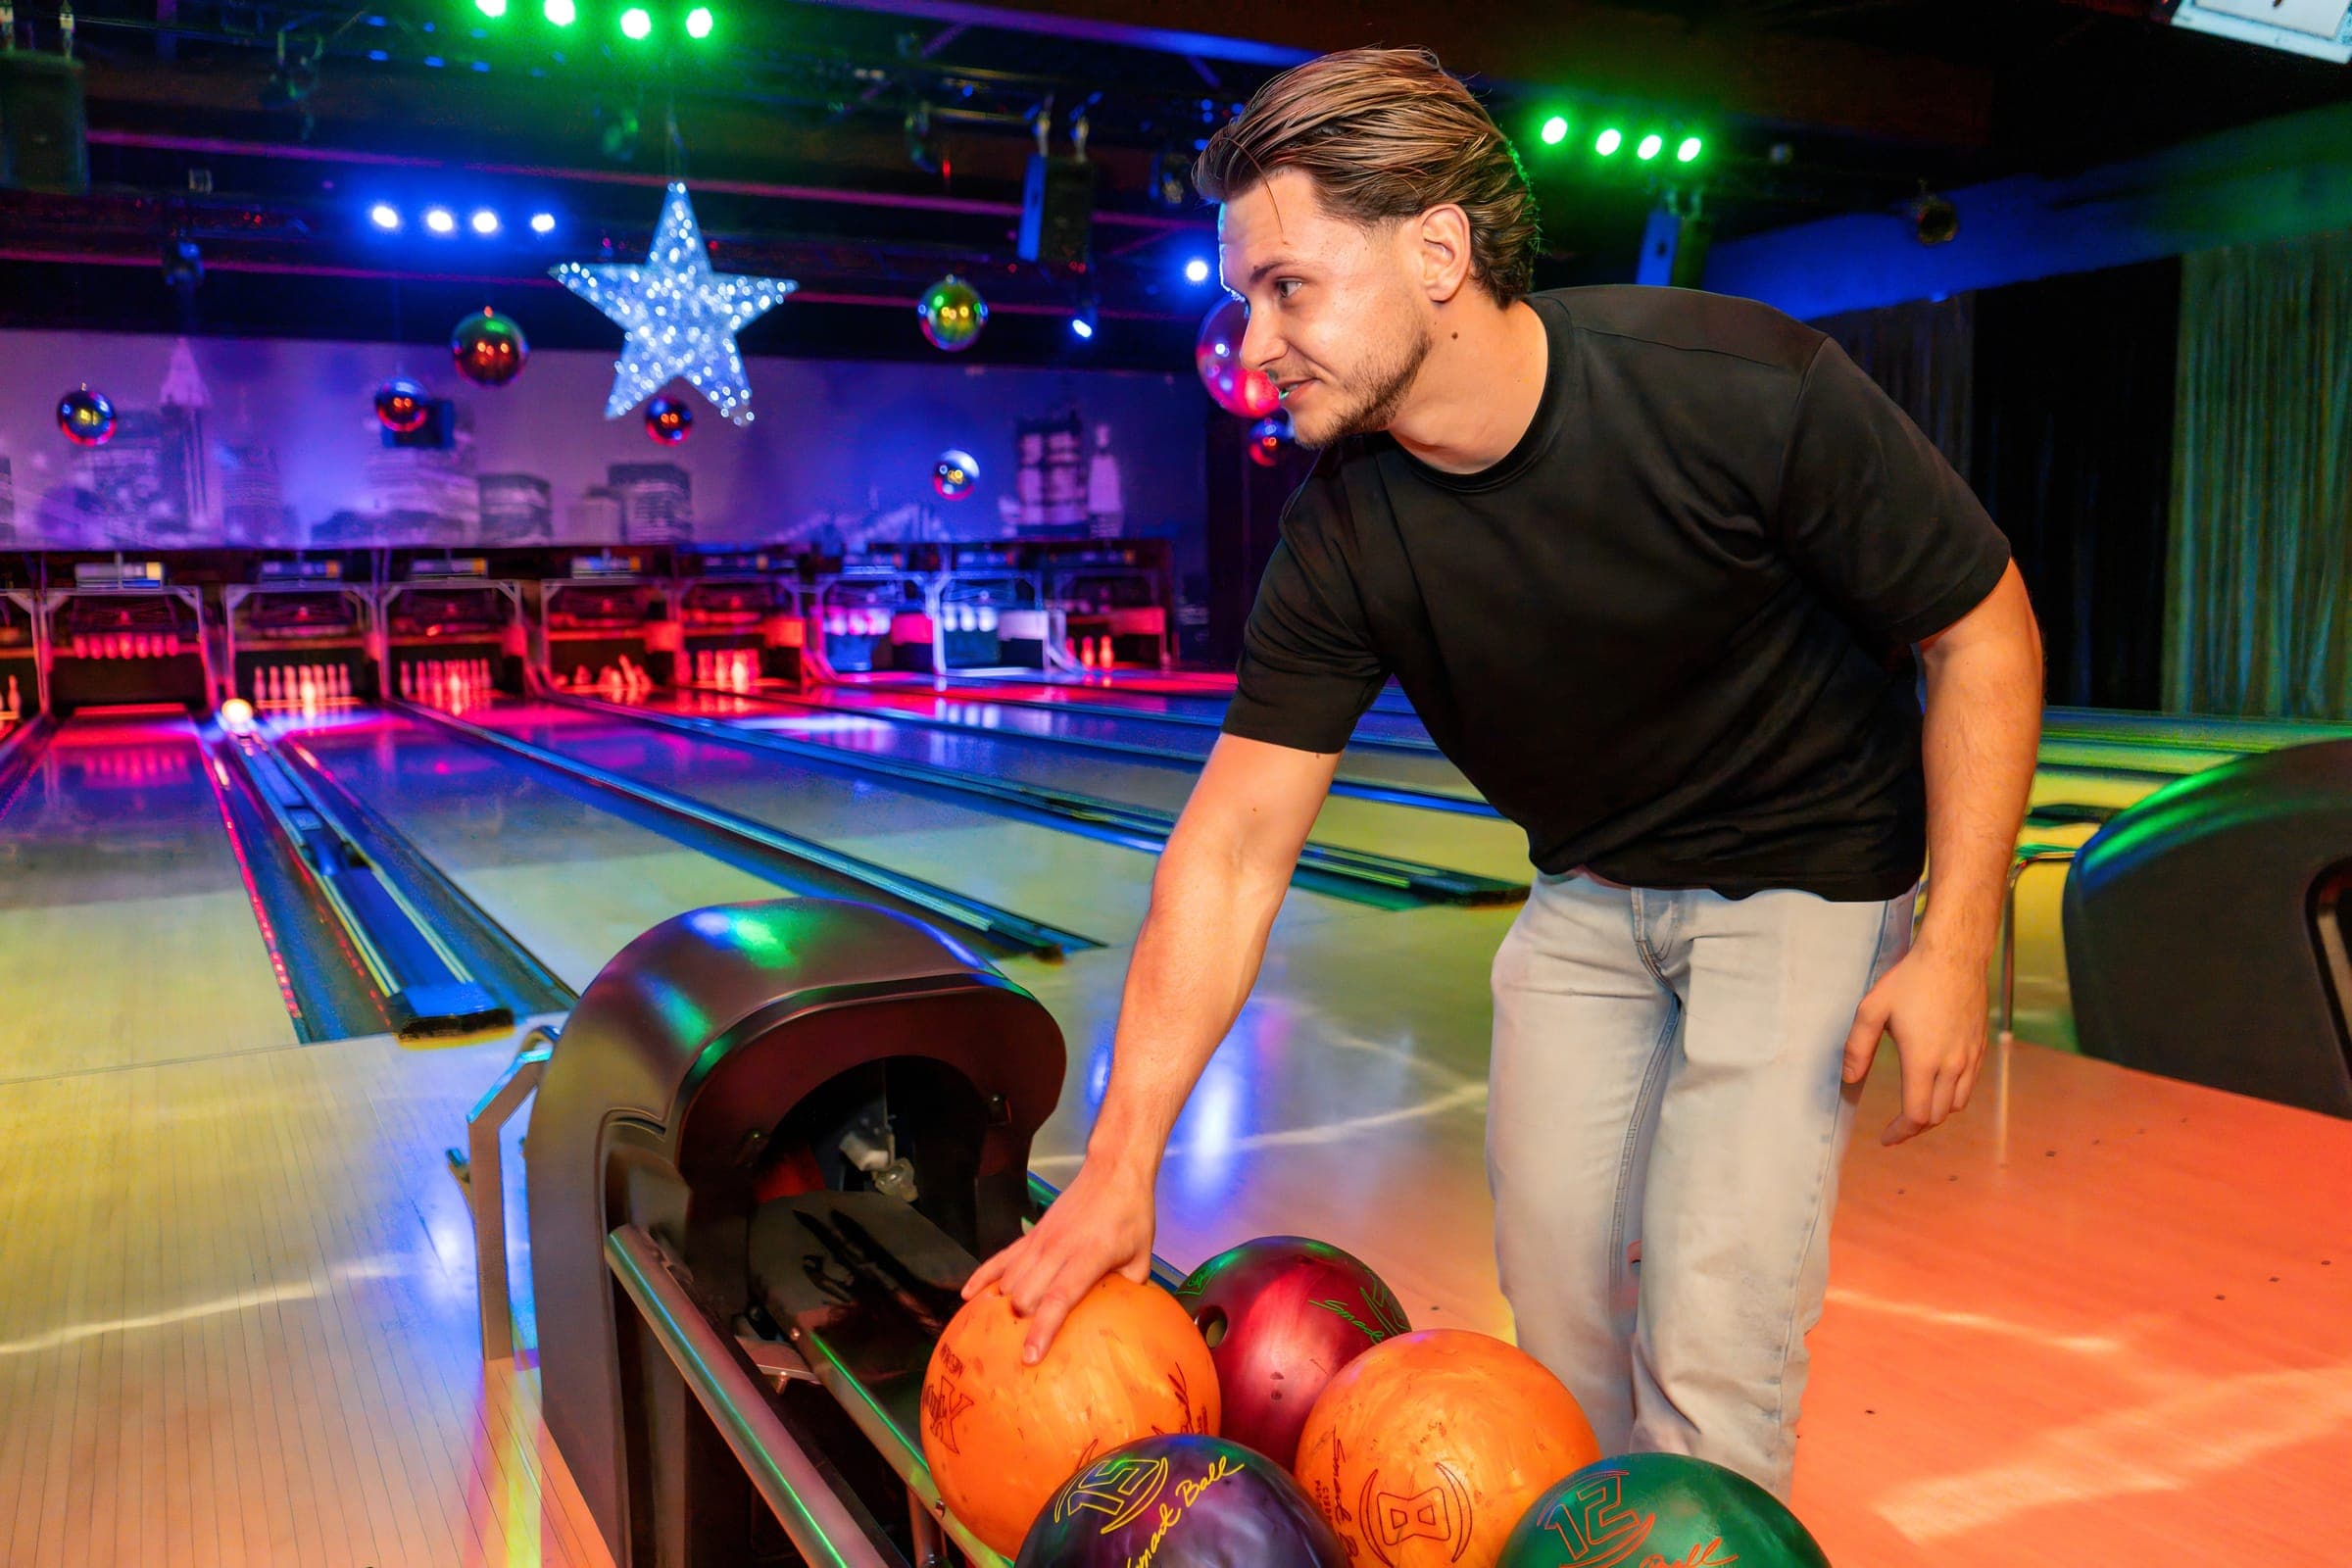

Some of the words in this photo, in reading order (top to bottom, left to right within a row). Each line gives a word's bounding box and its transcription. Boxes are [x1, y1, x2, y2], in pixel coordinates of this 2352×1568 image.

[1067, 1459, 1160, 1517] 15
[1127, 1502, 1182, 1568] mart
[1176, 1455, 1245, 1508] Ball
[1544, 1474, 1641, 1560] 12
